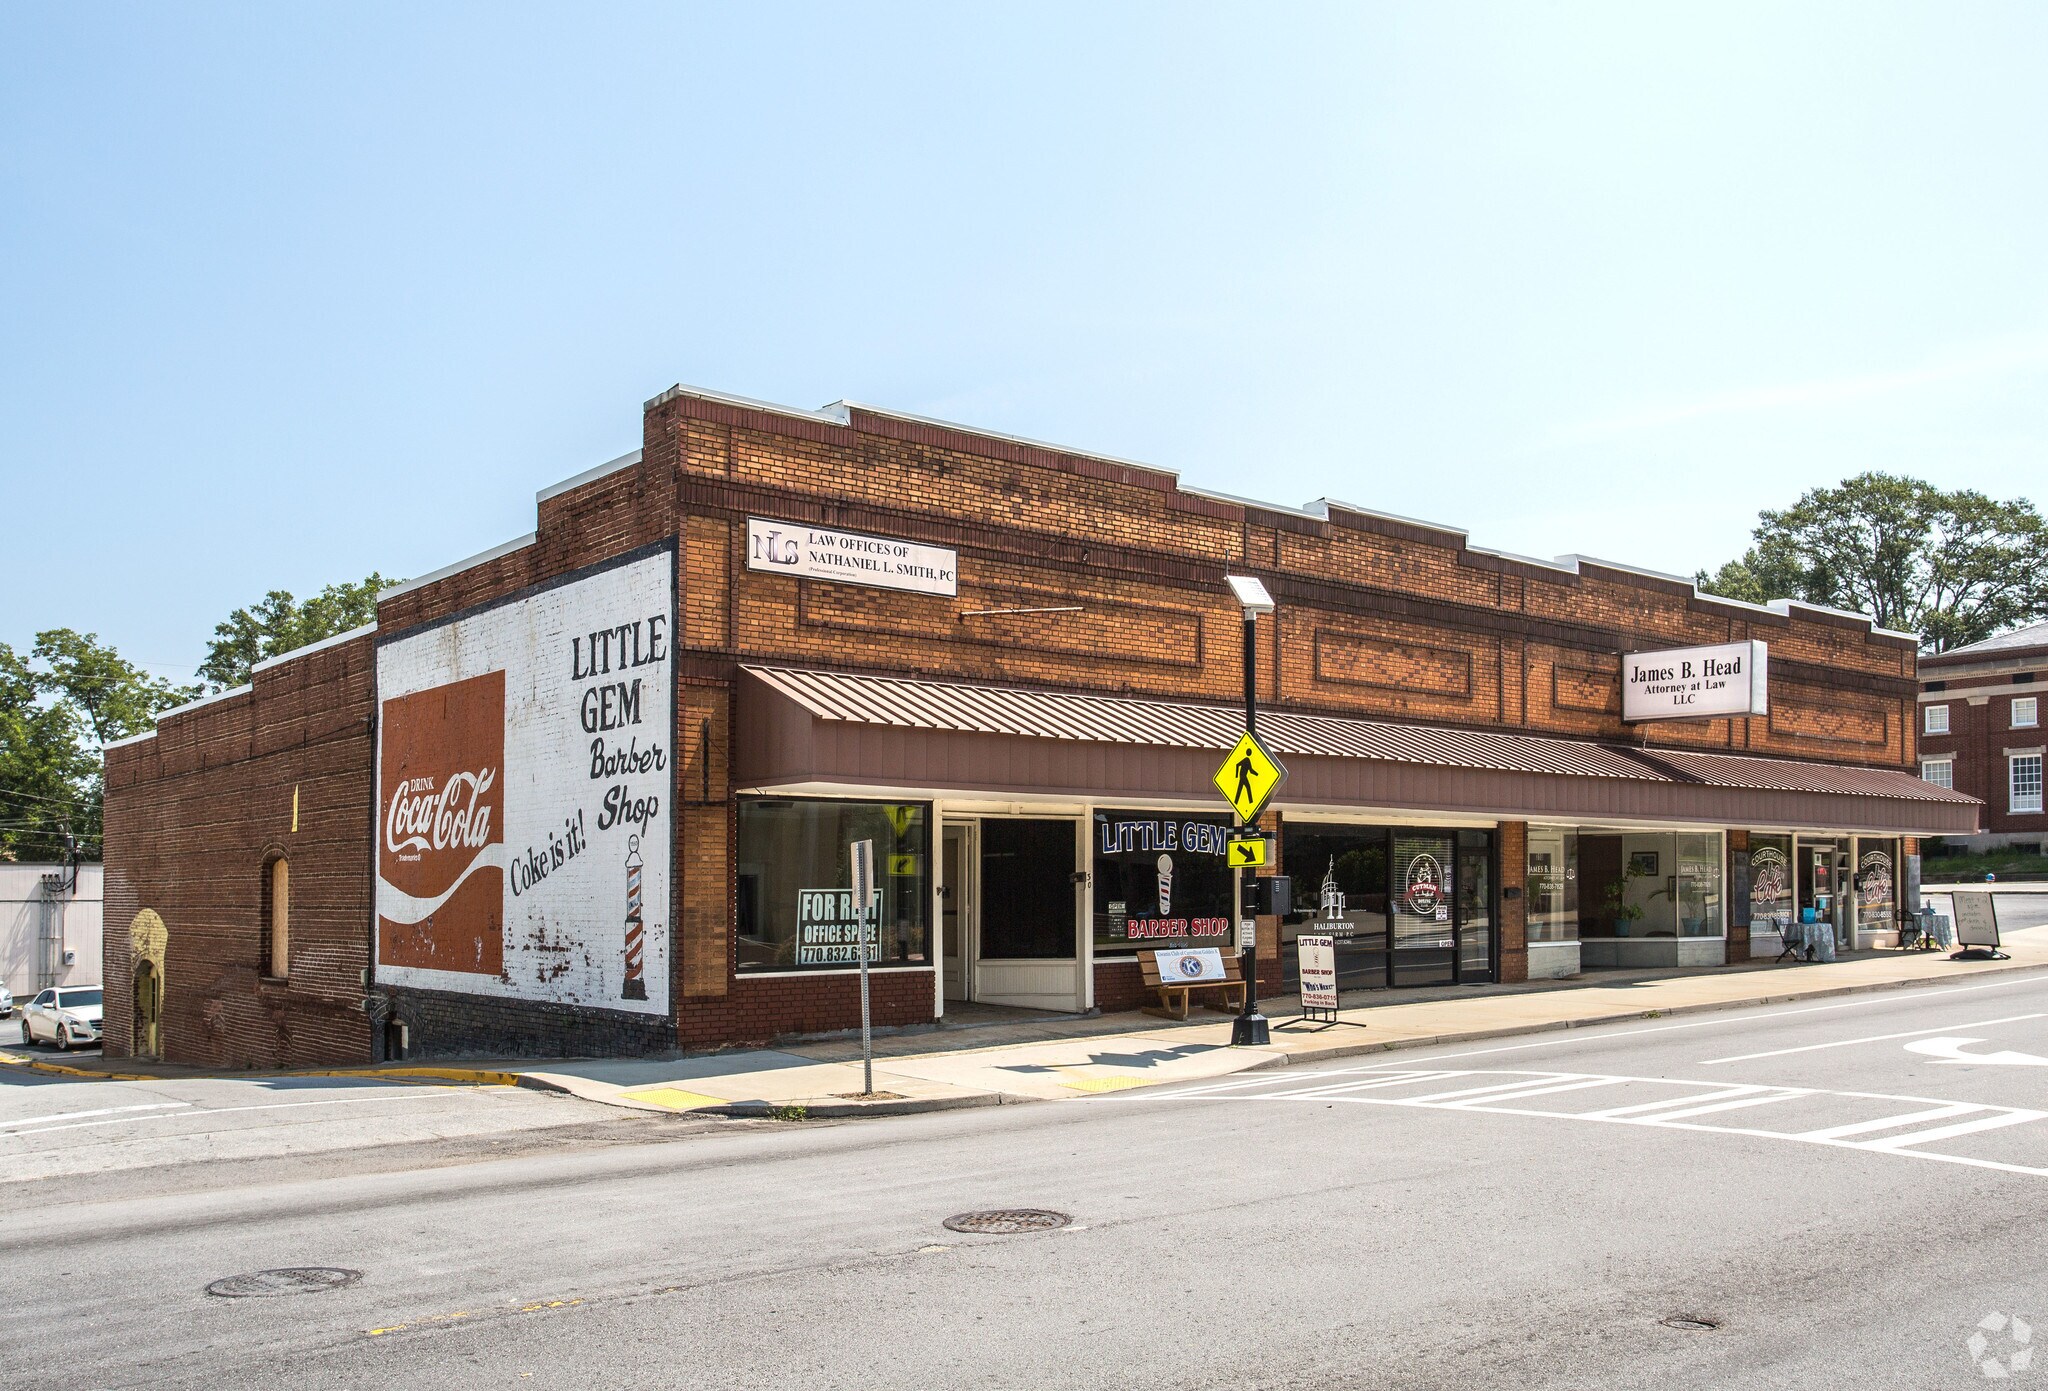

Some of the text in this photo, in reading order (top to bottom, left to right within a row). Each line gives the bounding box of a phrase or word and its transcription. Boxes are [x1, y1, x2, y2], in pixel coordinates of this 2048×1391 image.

[809, 532, 909, 558] LAW OFFICES OF
[809, 551, 954, 582] NATHANIEL L. SMITH, PC
[571, 614, 667, 681] LITTLE
[1630, 656, 1741, 684] James B. Head
[1644, 680, 1726, 695] Attorney at Law
[1673, 694, 1696, 705] LLC
[580, 678, 642, 734] GEM
[590, 736, 667, 780] Barber
[410, 776, 435, 792] DRINK
[386, 766, 497, 853] Coca-Cola
[597, 784, 659, 838] Shop
[1102, 820, 1227, 856] LITTLE GEM
[510, 808, 586, 897] Coke is it!
[1751, 850, 1788, 867] COURTHOUSE
[1861, 853, 1892, 869] COURTHOUSE
[1412, 883, 1437, 892] CUTMAN
[802, 893, 879, 921] FOR RT
[804, 924, 842, 943] OFFICE
[1127, 918, 1188, 939] BARBER
[1191, 917, 1229, 937] SHOP
[1314, 922, 1354, 930] HALIBURTON
[1299, 938, 1319, 946] LITTLE
[1320, 939, 1332, 947] GEM
